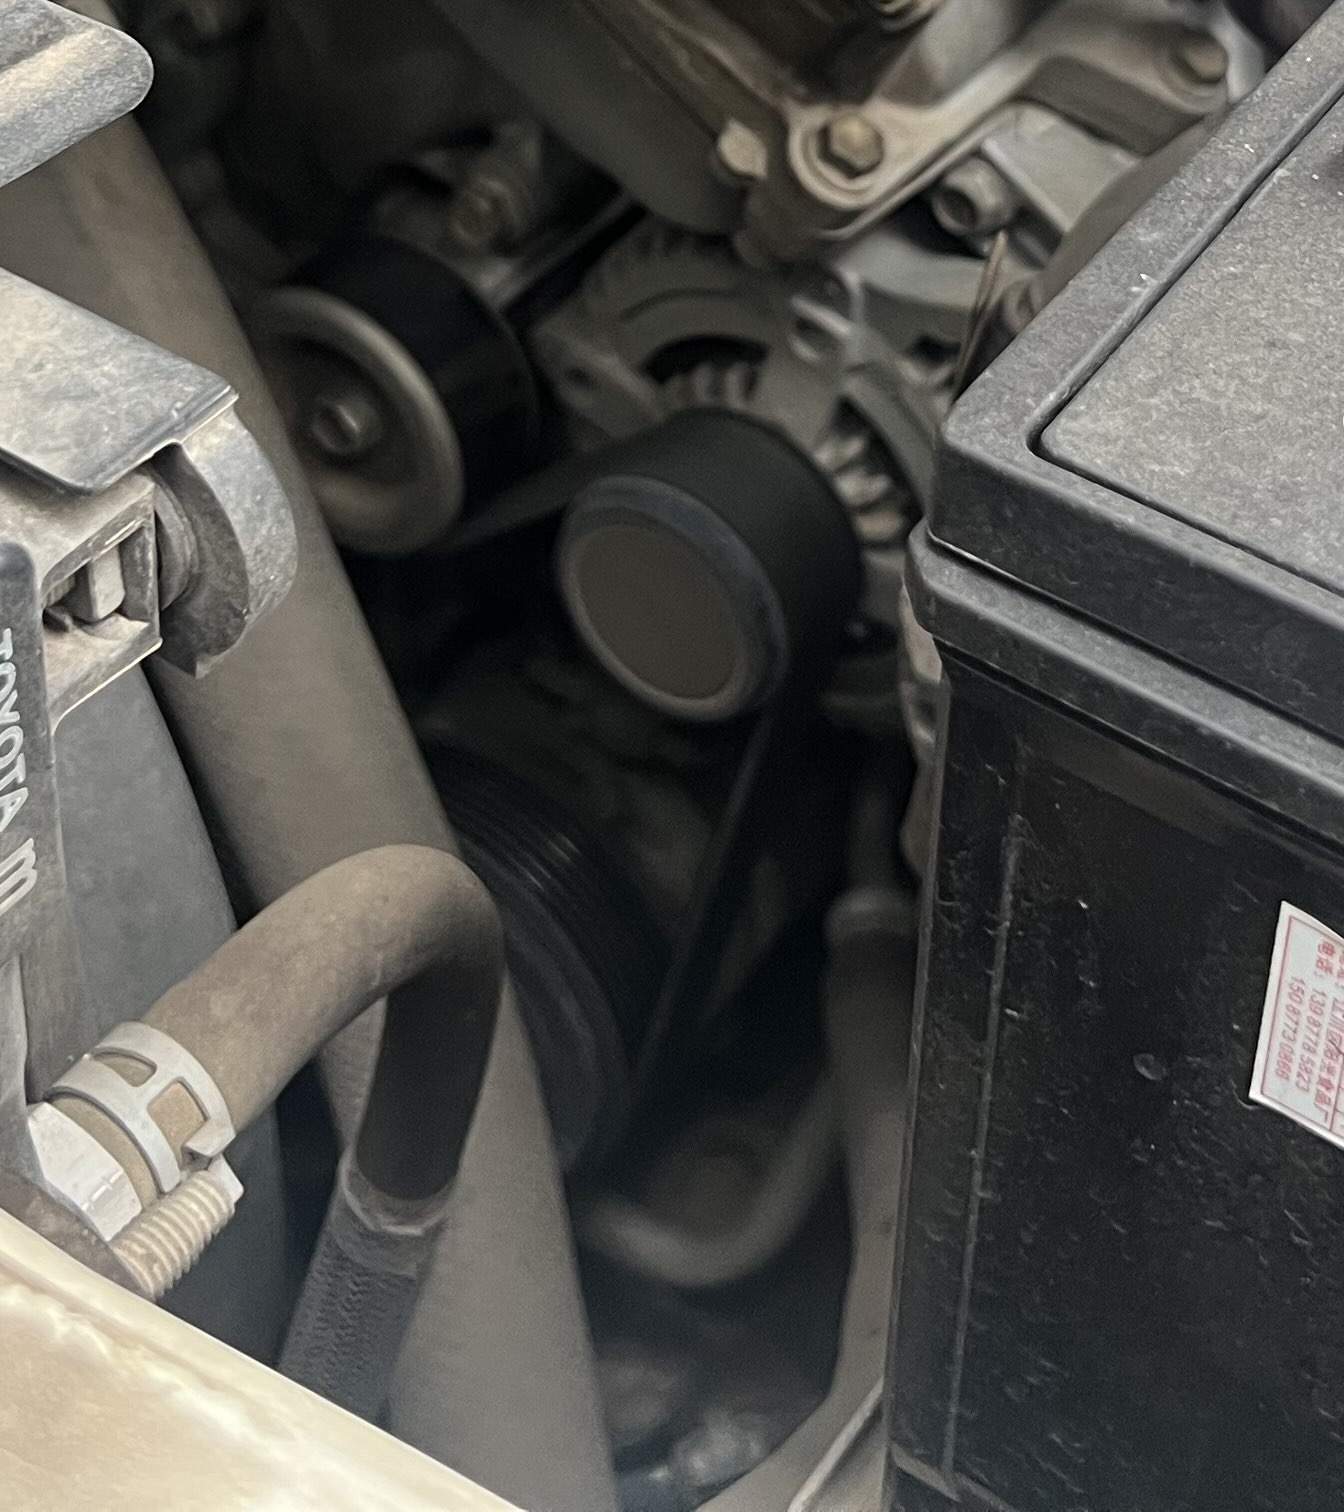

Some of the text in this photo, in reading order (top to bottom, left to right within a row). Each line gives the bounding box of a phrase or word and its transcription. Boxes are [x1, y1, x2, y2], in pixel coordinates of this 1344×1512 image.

[1286, 971, 1305, 1007] 150
[1307, 984, 1327, 1018] 139
[1279, 1000, 1300, 1045] 8773
[1300, 1012, 1322, 1057] 8778
[1293, 1051, 1315, 1094] 5823
